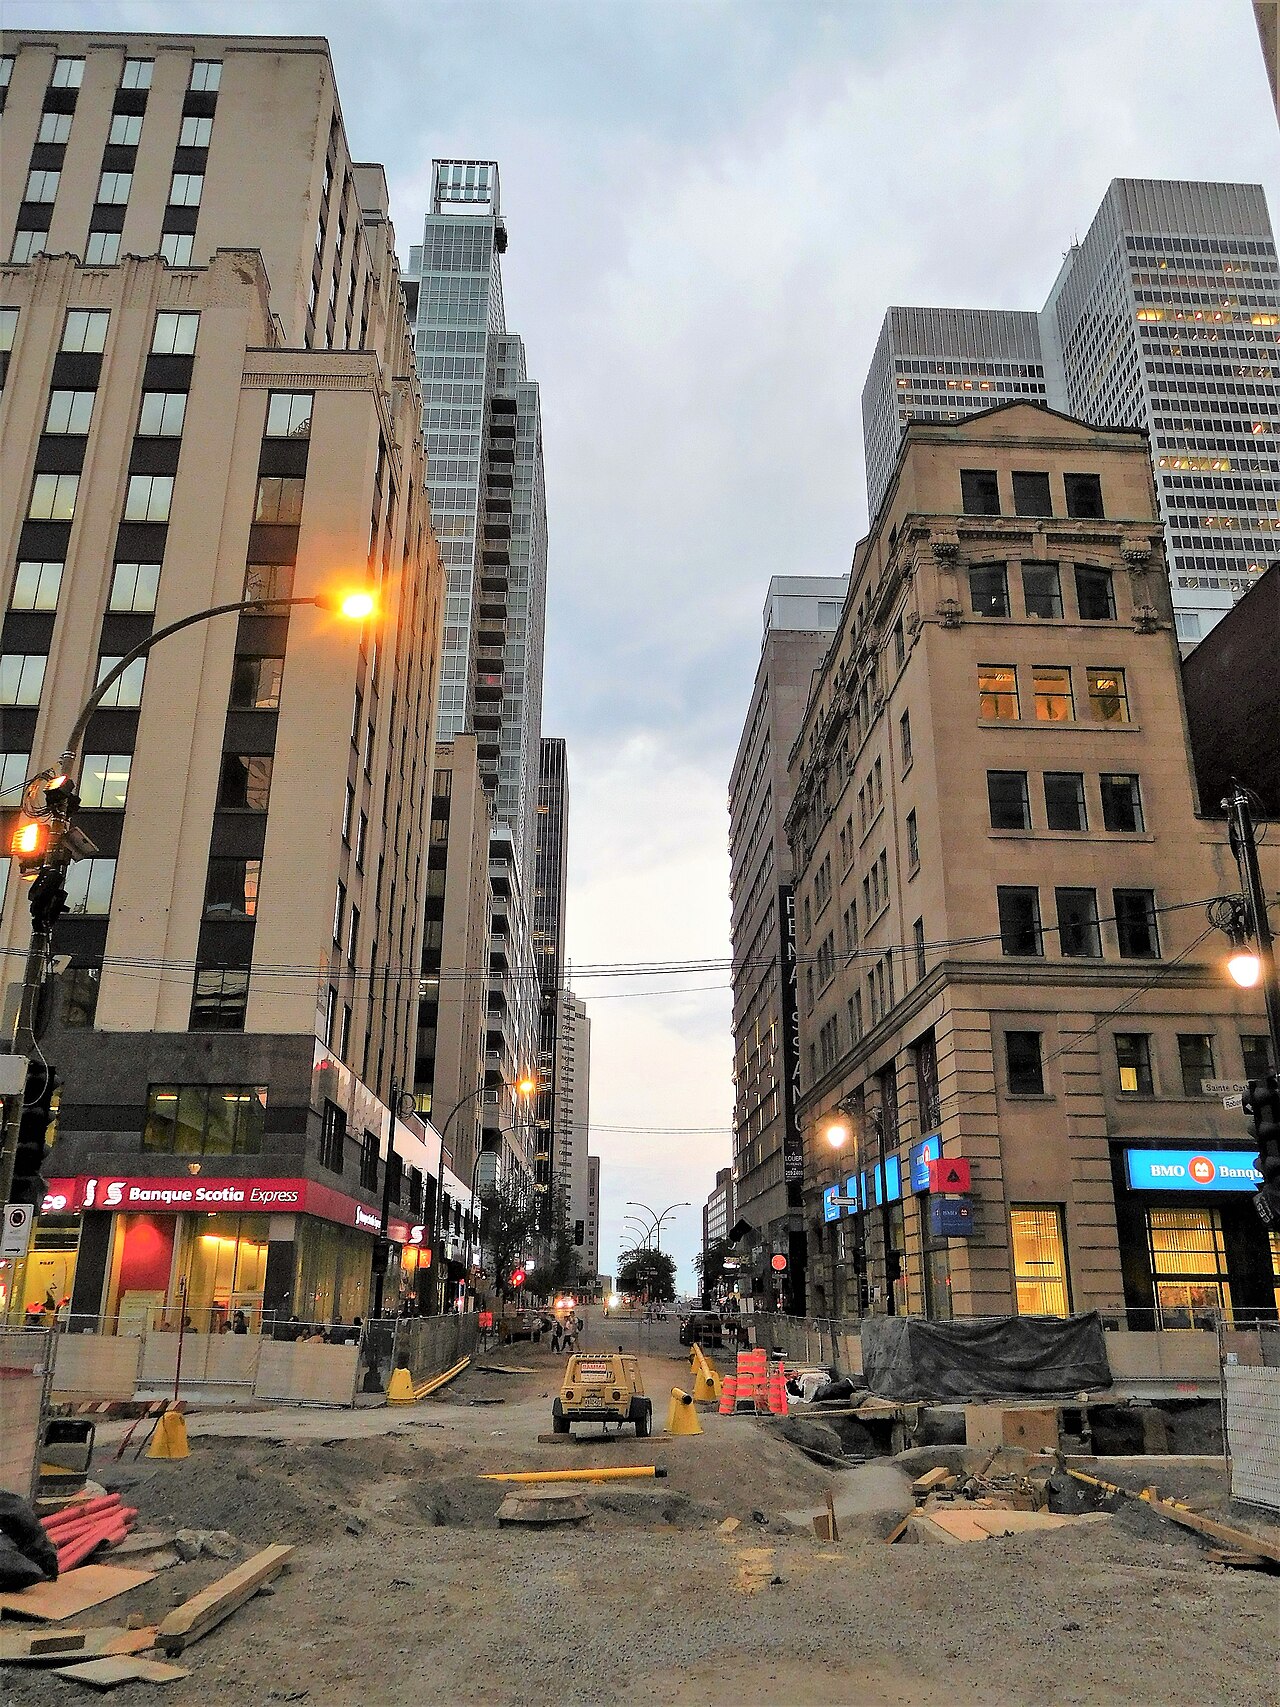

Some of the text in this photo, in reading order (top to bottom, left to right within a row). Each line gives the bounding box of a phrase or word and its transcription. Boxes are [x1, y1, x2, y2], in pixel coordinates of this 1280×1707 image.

[1150, 1165, 1186, 1177] BMO
[129, 1187, 192, 1205] Banque
[194, 1187, 244, 1202] Scotia
[249, 1187, 299, 1205] Express
